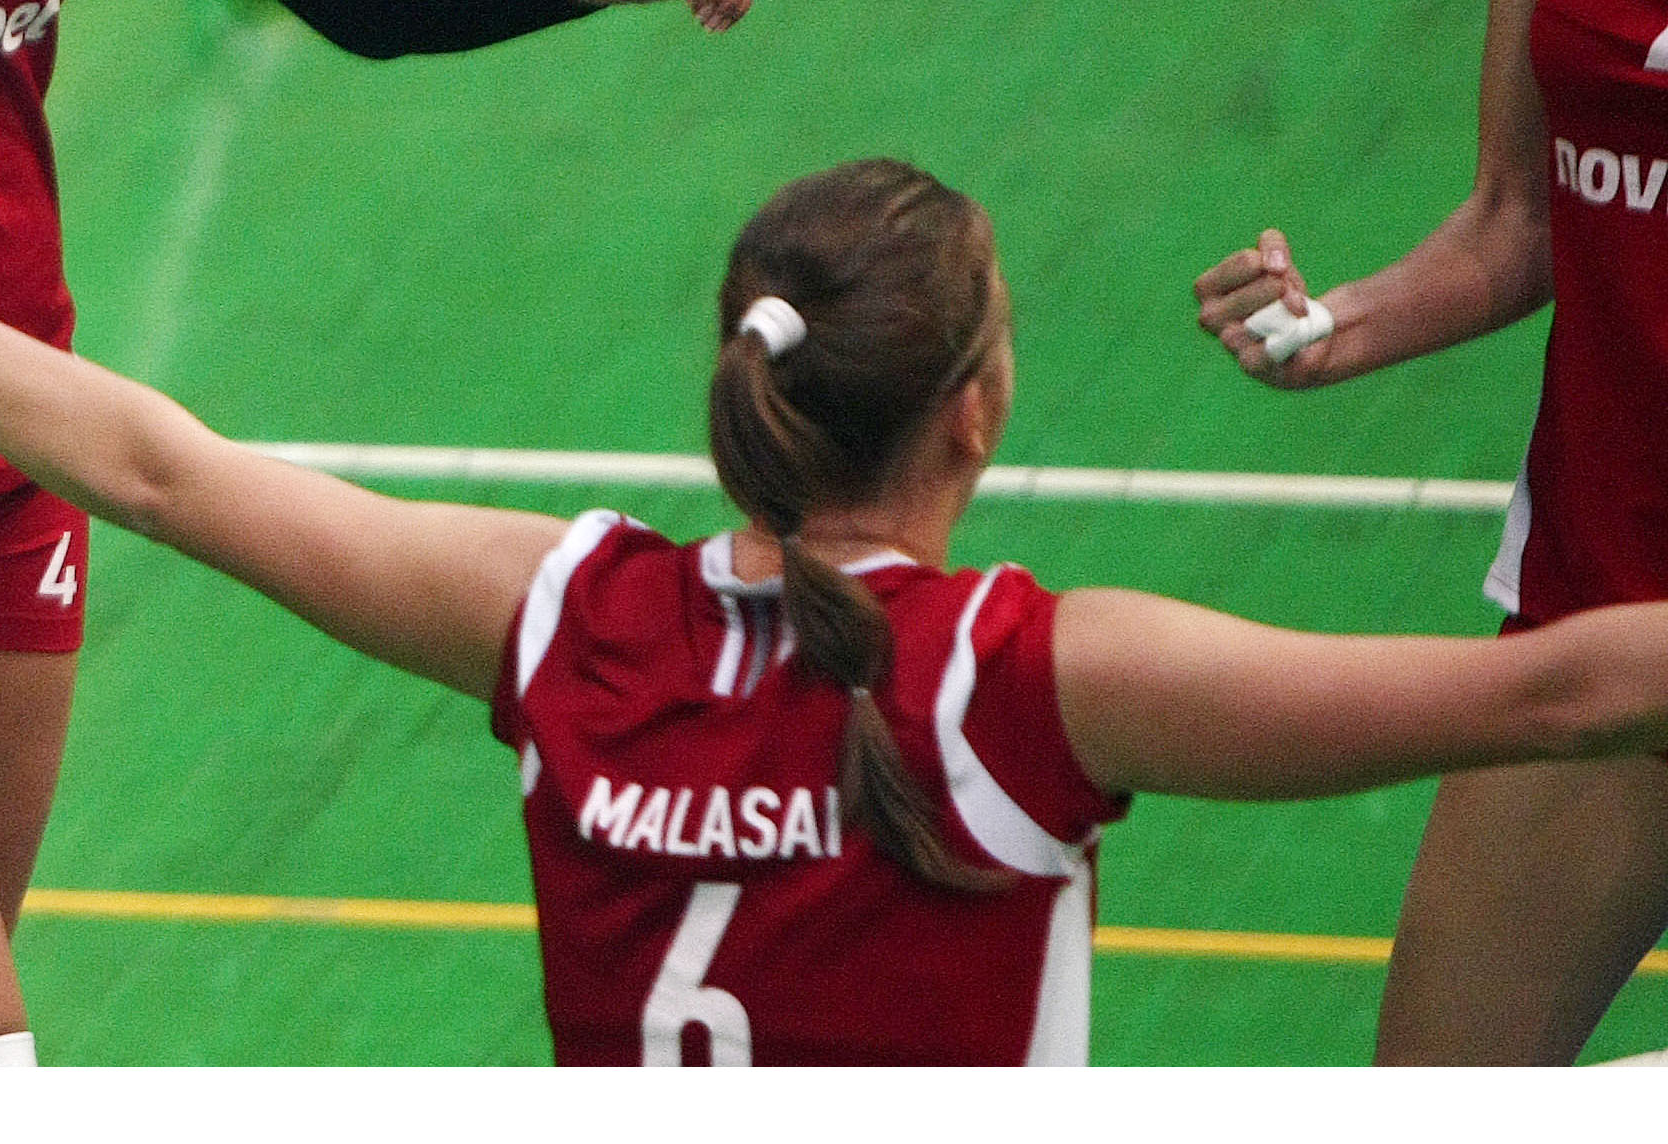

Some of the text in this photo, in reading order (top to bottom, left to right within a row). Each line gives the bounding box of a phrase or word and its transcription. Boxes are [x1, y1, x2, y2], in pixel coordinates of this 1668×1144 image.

[1554, 136, 1668, 212] nov
[38, 530, 78, 606] 4
[577, 775, 842, 859] MALASAI
[641, 883, 752, 1067] 6
